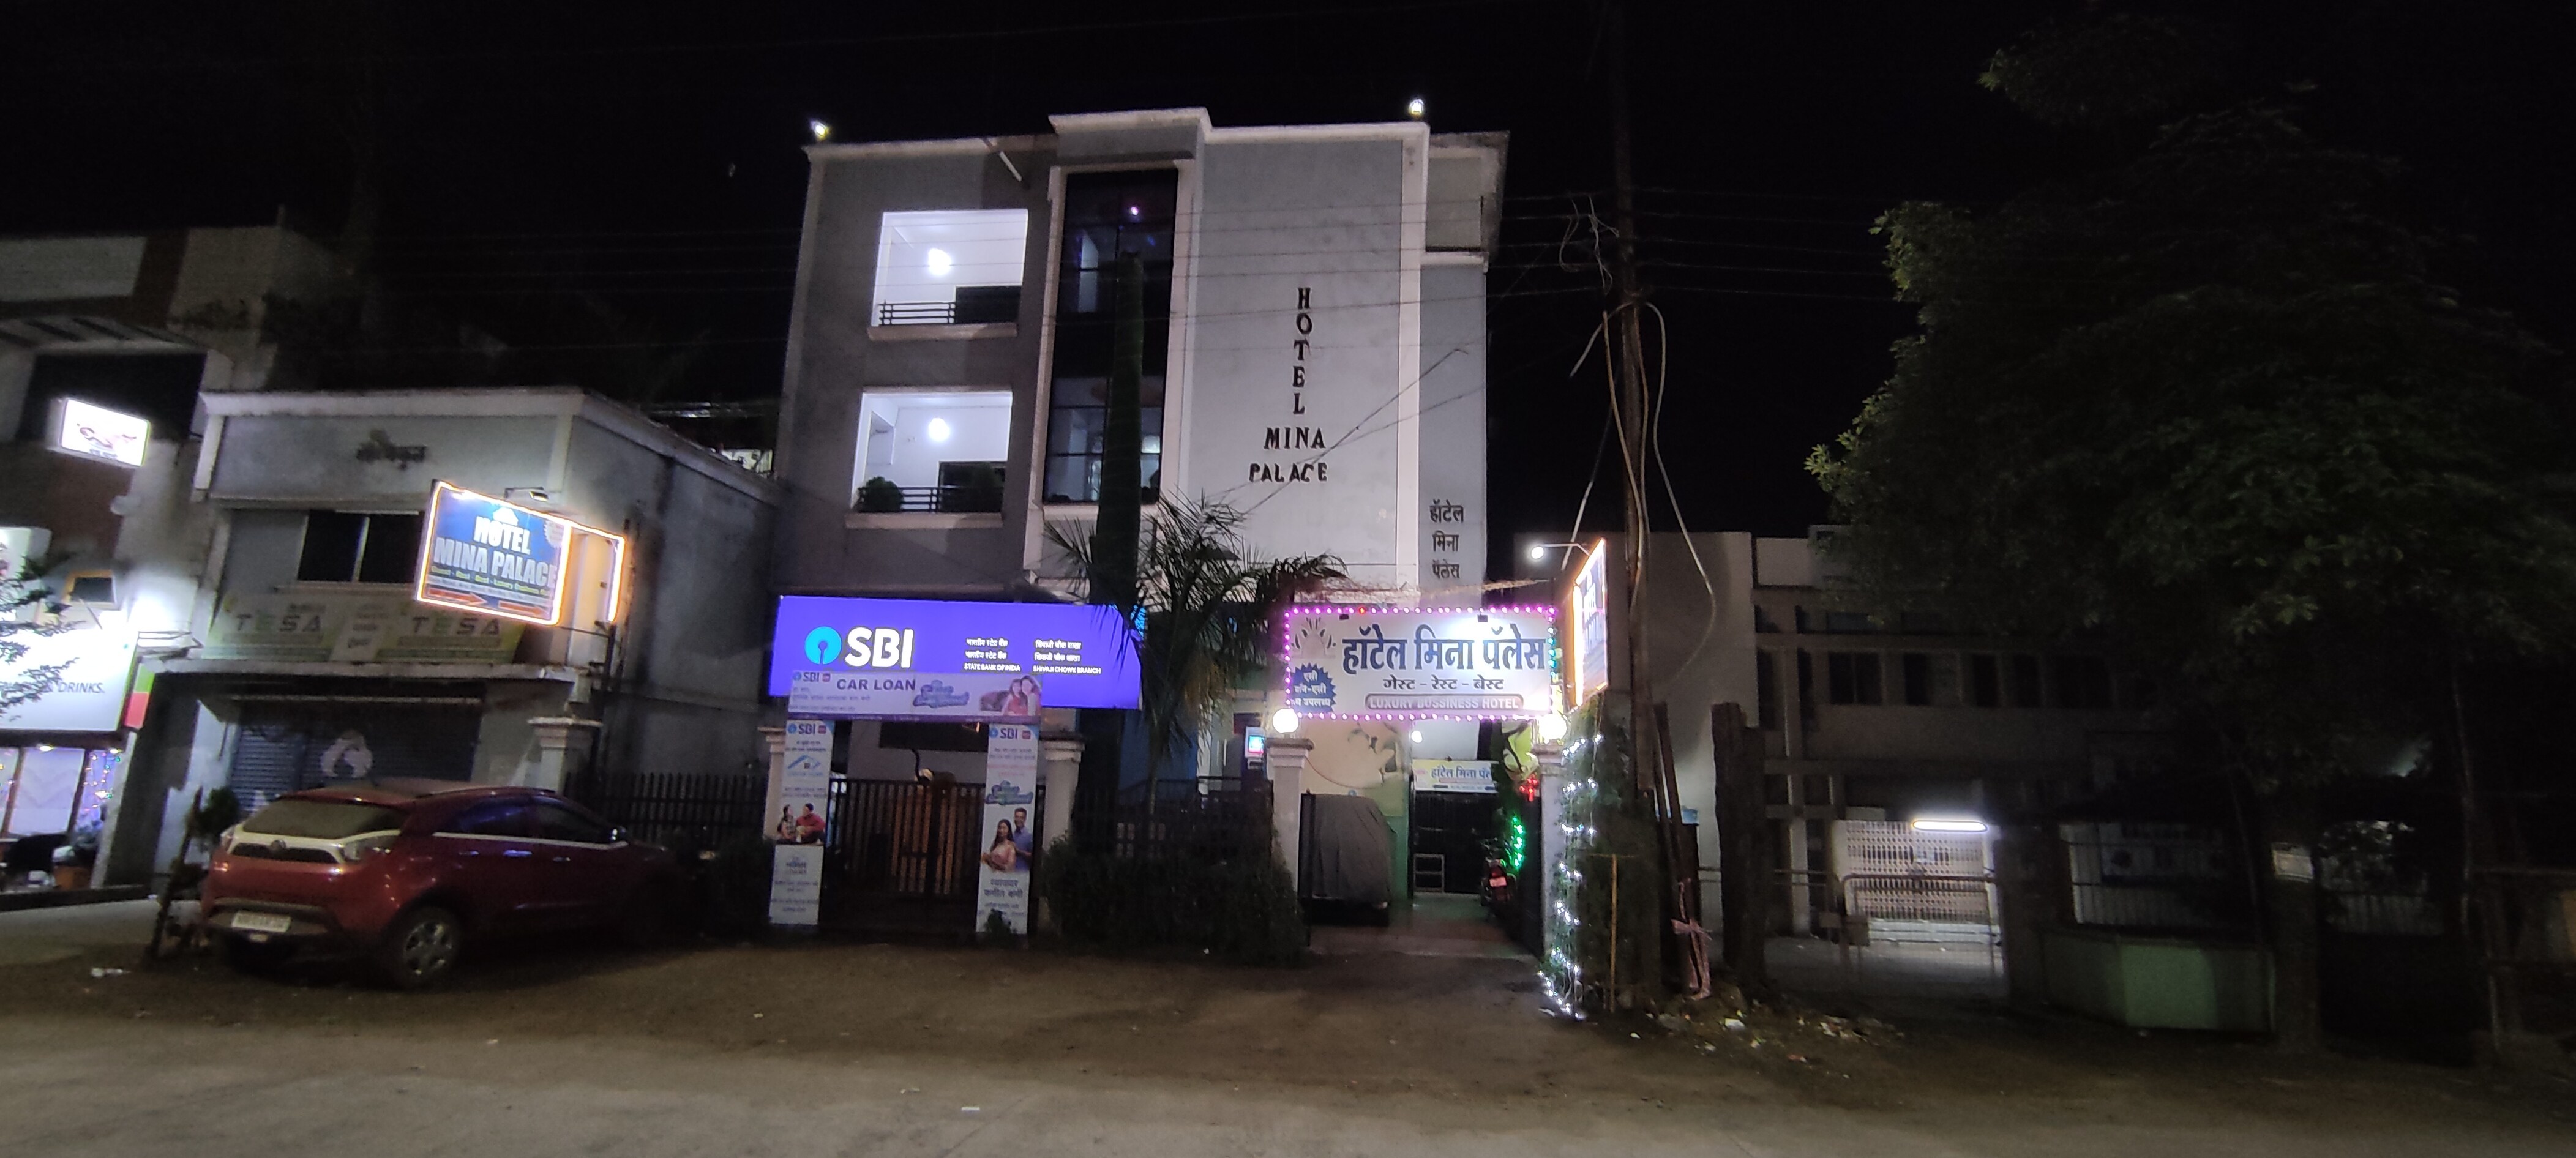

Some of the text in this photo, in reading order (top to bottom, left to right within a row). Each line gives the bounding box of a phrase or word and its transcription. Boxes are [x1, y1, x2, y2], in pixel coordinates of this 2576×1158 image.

[1292, 287, 1312, 415] HOTEL
[1264, 427, 1326, 449] MINA
[1249, 463, 1327, 482] PALACE
[1429, 499, 1464, 523] हॉटेल
[473, 515, 531, 555] HOTEL
[1432, 530, 1459, 551] मिना
[433, 536, 488, 574] MINA
[491, 550, 558, 589] PALACE
[236, 613, 500, 635] TESA TESA
[845, 627, 914, 668] SBI
[1342, 624, 1546, 674] हॉटेल मिना पॅलेस
[803, 672, 820, 682] SBI
[837, 679, 916, 690] CAR LOAN
[1303, 670, 1318, 682] एसी
[1383, 674, 1505, 690] गेस्ट रेस्ट बेस्ट
[1369, 699, 1413, 709] LUXURY
[1482, 699, 1520, 709] HOTEL
[798, 723, 816, 735] SBI
[1000, 728, 1018, 739] SBI
[1456, 765, 1476, 779] मिना
